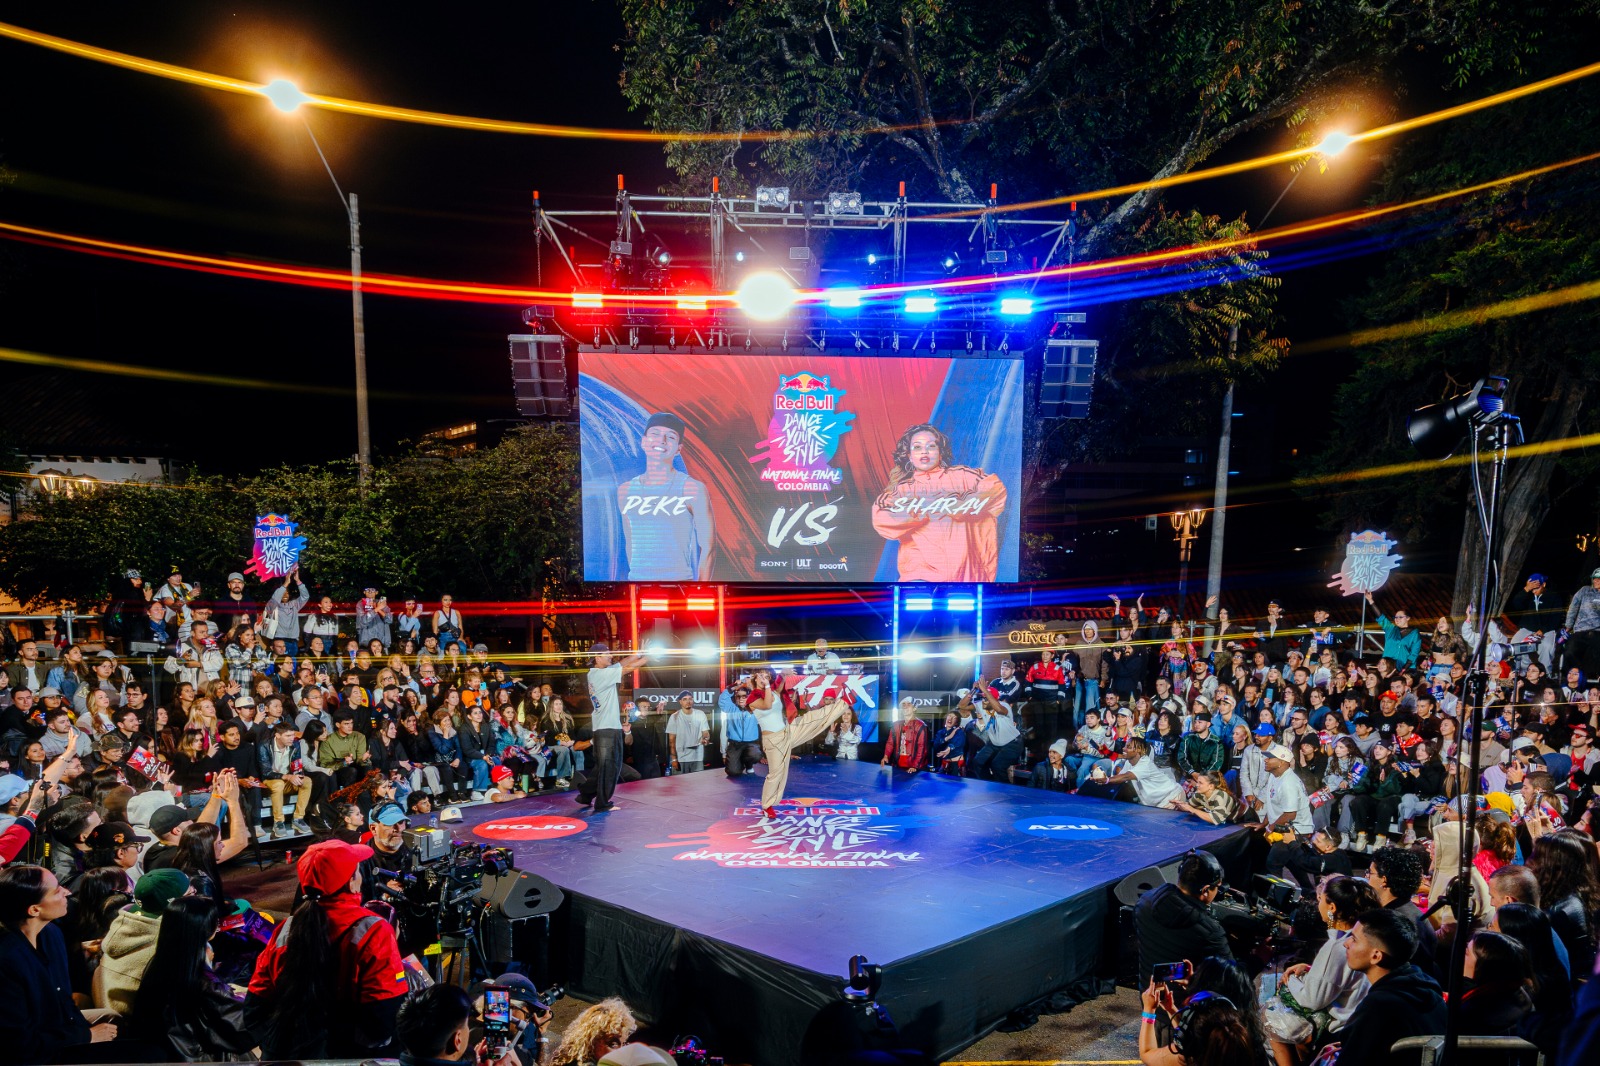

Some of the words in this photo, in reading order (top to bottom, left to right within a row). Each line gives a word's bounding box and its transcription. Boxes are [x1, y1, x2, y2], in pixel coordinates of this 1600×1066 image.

[776, 394, 804, 410] Red
[806, 394, 833, 410] Bull
[782, 412, 824, 432] DANCE
[785, 426, 828, 446] YOUR
[782, 439, 825, 466] STYLE
[761, 468, 810, 482] NATIONAL
[810, 468, 841, 483] FINAL
[777, 482, 830, 491] COLOMBIA
[621, 495, 694, 516] PEKE
[889, 496, 990, 515] SHARAY
[767, 499, 843, 548] VS
[255, 527, 274, 538] Red
[274, 526, 292, 537] Bull
[261, 537, 290, 553] DANCE
[1347, 544, 1367, 554] Red
[1367, 544, 1388, 554] Bull
[265, 546, 295, 563] YOUR
[796, 558, 812, 567] ULT
[1351, 554, 1384, 569] DANCE
[265, 556, 294, 576] STYLE
[1353, 563, 1385, 580] YOUR
[1350, 572, 1384, 592] STYLE
[692, 691, 715, 704] ULT
[911, 698, 943, 706] ONY
[733, 807, 808, 816] Rd
[810, 807, 881, 815] Bull
[746, 815, 871, 828] DANCE
[757, 823, 888, 838] YOUR
[747, 831, 880, 851] STYLE
[678, 850, 828, 861] NATIONAL
[833, 849, 925, 861] FINAL
